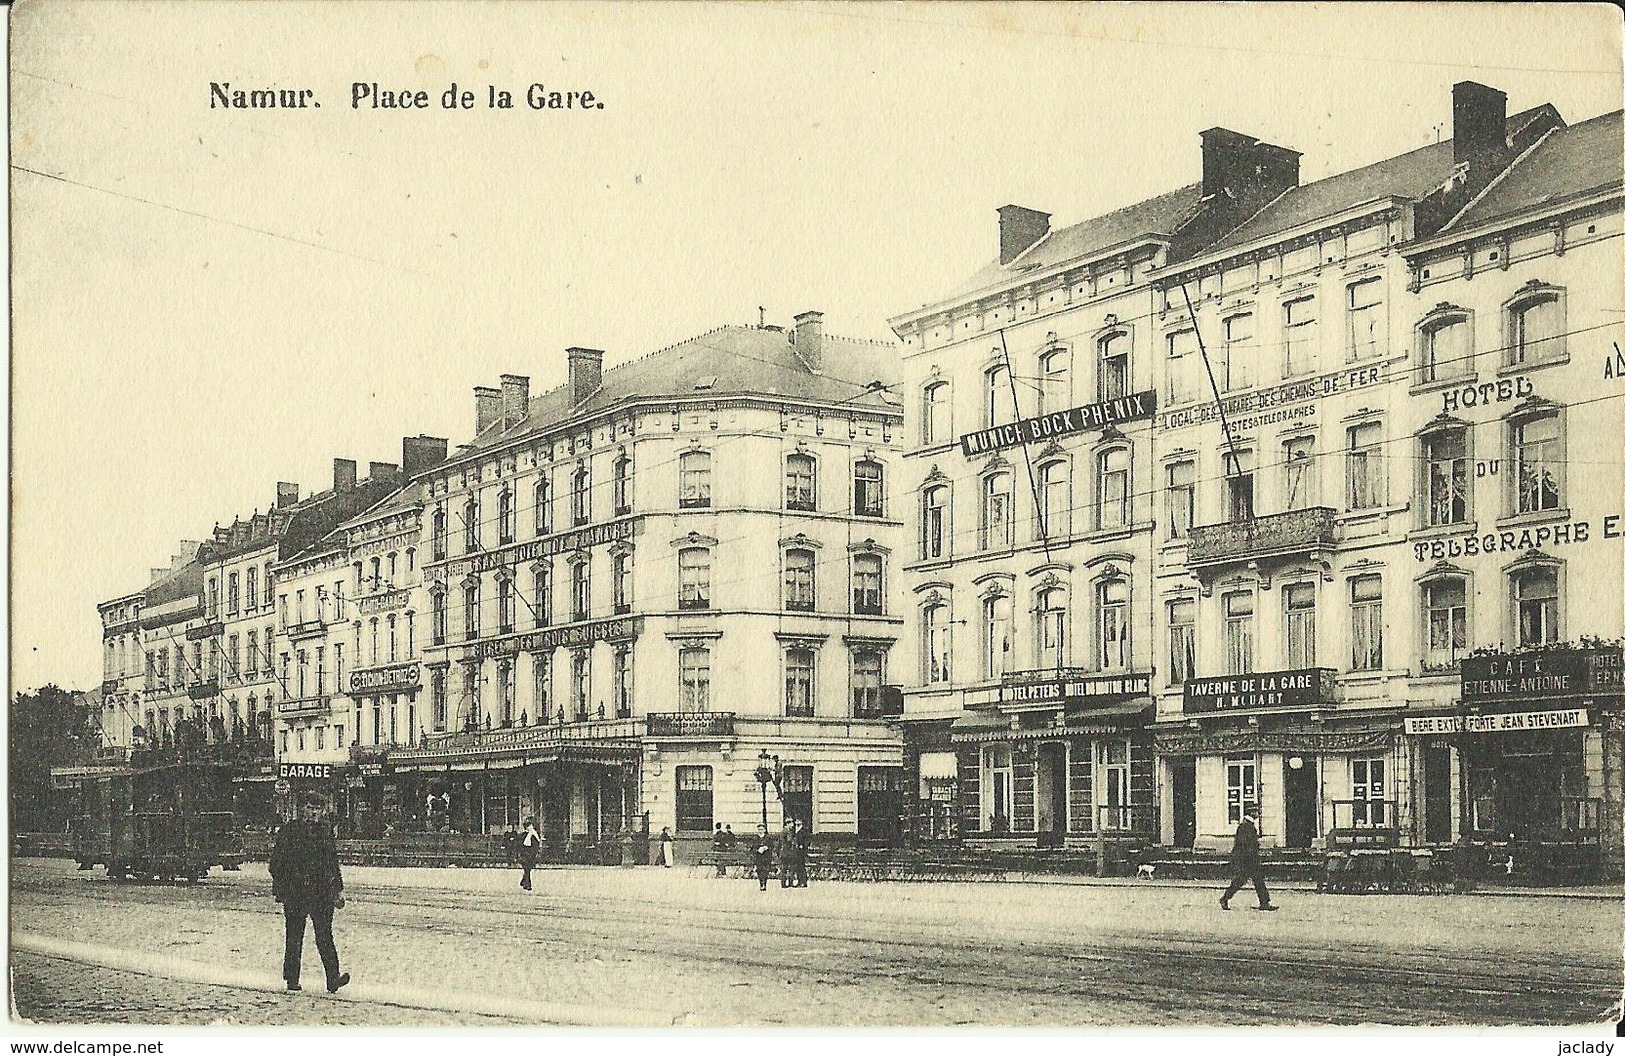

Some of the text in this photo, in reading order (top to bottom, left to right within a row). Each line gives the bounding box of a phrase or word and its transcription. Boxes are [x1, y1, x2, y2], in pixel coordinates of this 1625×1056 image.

[1164, 411, 1195, 430] LOCAL
[1259, 391, 1277, 409] DES
[1323, 376, 1339, 394] DE
[1350, 367, 1379, 388] FER
[1030, 412, 1075, 439] BOCK
[1476, 459, 1500, 478] DU
[1029, 683, 1060, 700] PETERS
[1190, 674, 1312, 697] TAVERNE DE LA GARE
[1464, 675, 1570, 695] ETIENNE-ANTOINE
[1469, 714, 1496, 730] FORTE
[1500, 715, 1524, 729] JEAN
[1527, 711, 1580, 728] STEVENART
[280, 764, 330, 778] GARAGE
